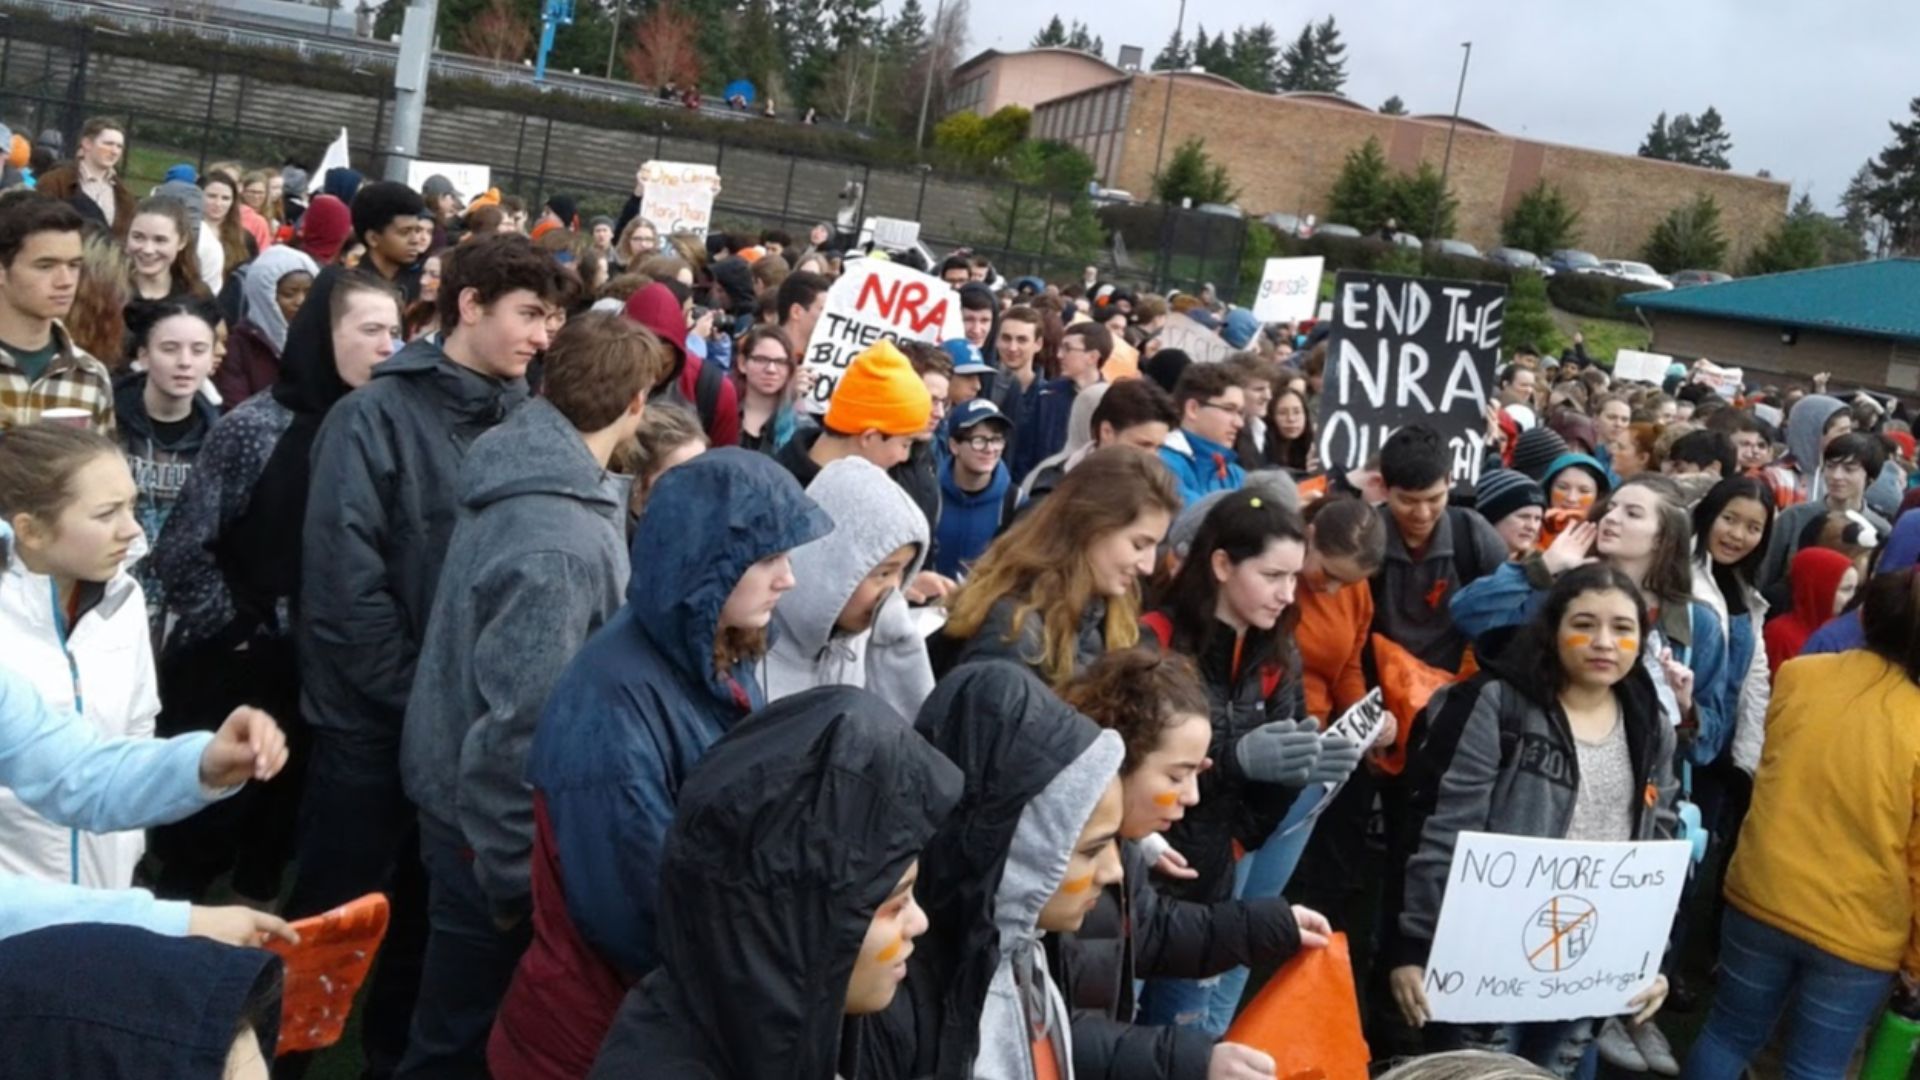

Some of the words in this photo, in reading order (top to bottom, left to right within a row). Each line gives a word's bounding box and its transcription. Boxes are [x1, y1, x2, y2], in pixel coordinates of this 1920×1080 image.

[855, 273, 948, 343] NRA
[1343, 281, 1432, 336] END
[1442, 287, 1504, 350] THE
[1339, 338, 1488, 419] NRA
[1461, 849, 1516, 888] NO
[1526, 854, 1605, 890] MORE
[1610, 848, 1666, 889] Guns
[1425, 968, 1465, 995] NO
[1476, 975, 1530, 997] MORE
